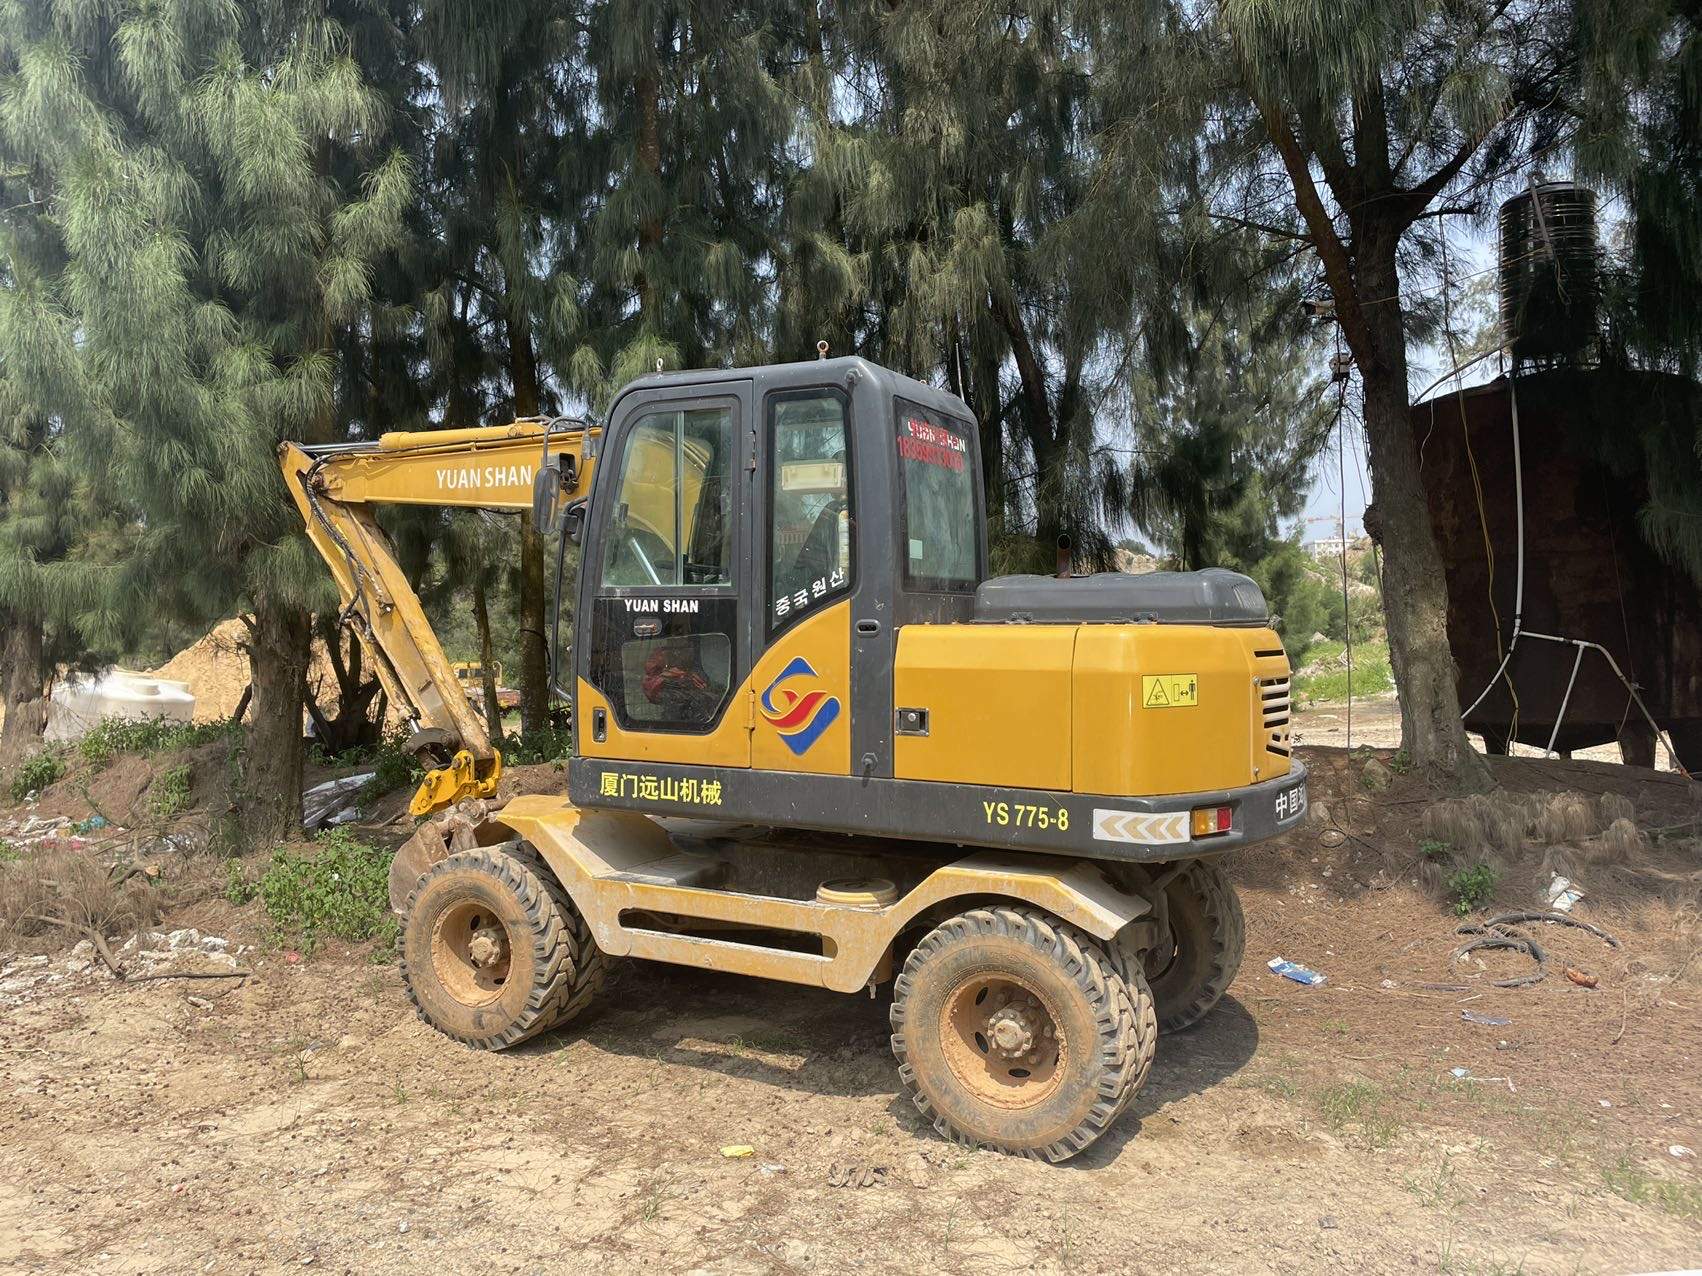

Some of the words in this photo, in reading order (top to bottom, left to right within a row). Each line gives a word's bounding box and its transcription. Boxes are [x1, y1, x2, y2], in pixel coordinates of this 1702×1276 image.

[436, 467, 481, 489] YUAN
[484, 465, 532, 488] SHAN
[624, 599, 659, 612] YUAN
[663, 599, 699, 613] SHAN
[775, 566, 845, 616] 중국원산
[599, 771, 723, 806] 厦门远山机械
[983, 801, 1009, 826] YS
[1014, 804, 1069, 831] 775-8
